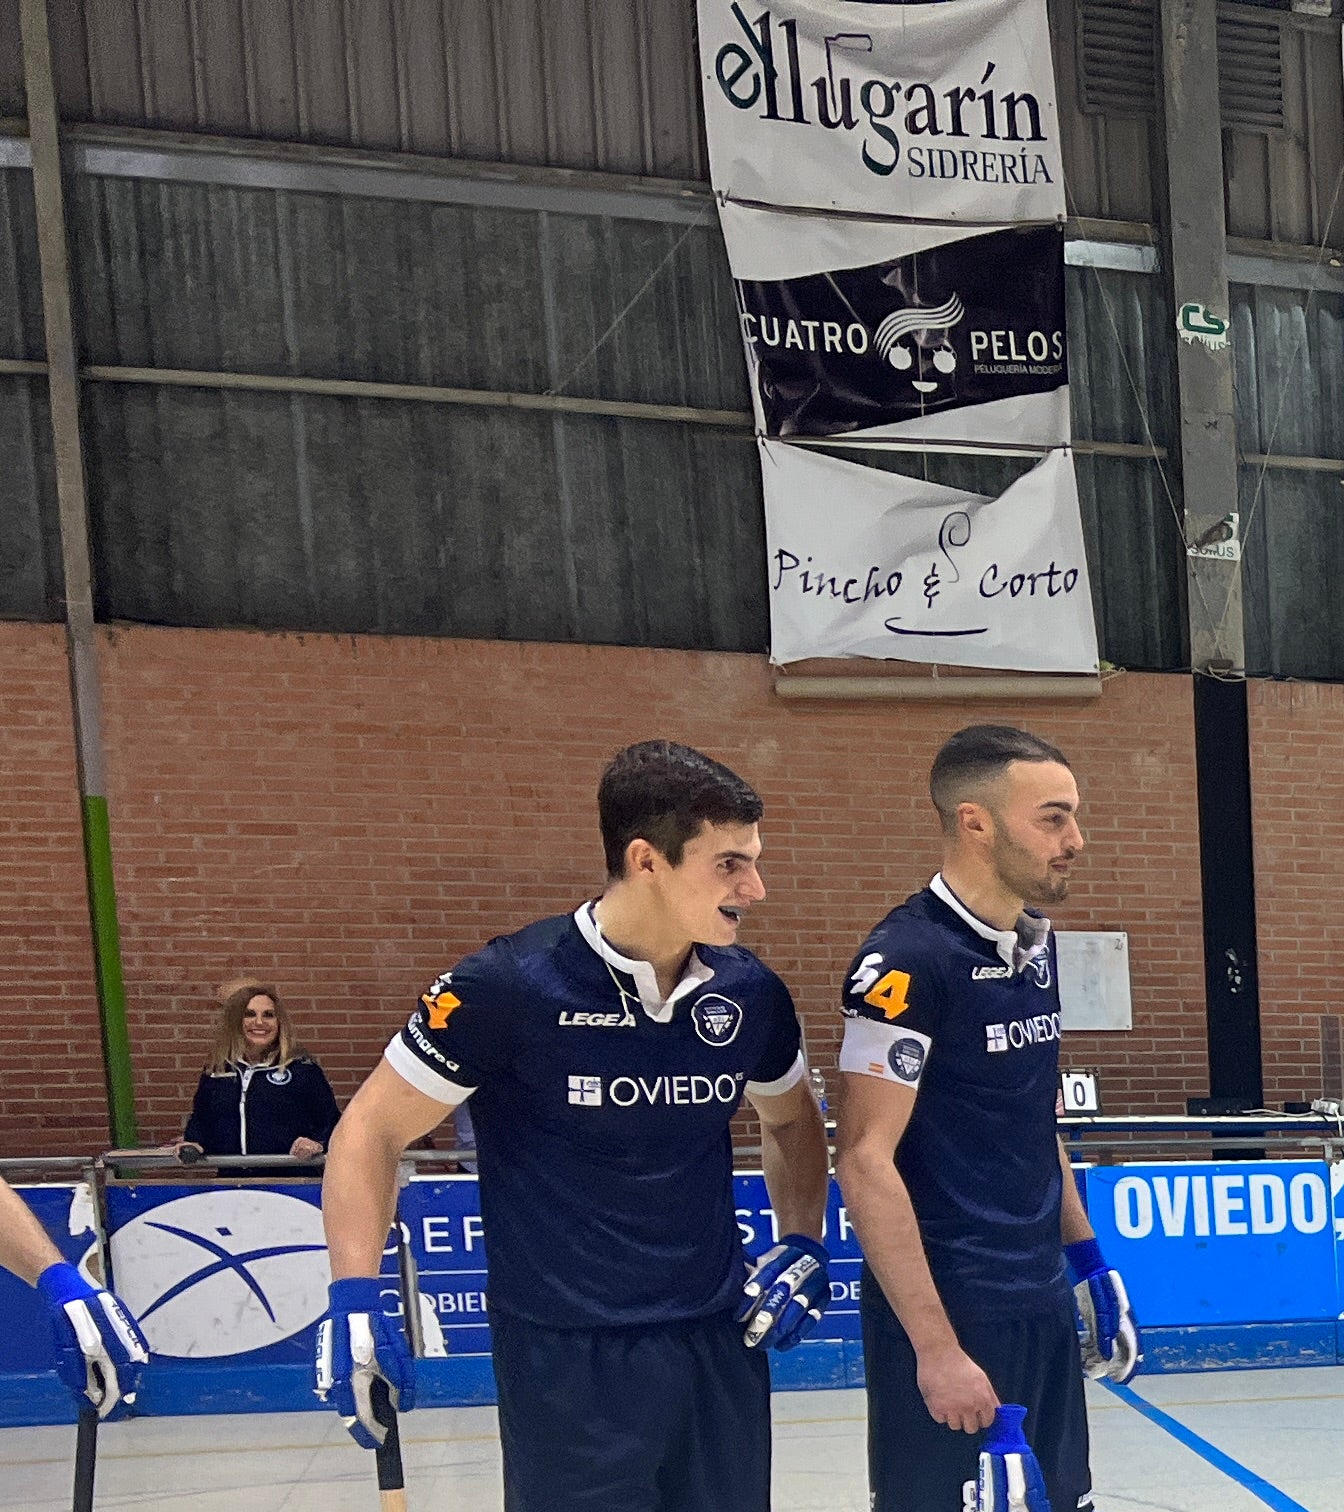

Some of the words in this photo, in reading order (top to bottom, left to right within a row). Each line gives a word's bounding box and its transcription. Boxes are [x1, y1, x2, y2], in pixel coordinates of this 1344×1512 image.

[908, 147, 1054, 184] SIDRERÍA
[741, 313, 868, 354] CUATRO
[970, 330, 1063, 361] PELOS
[774, 549, 902, 603] Pincho
[924, 563, 940, 608] &
[979, 562, 1079, 598] Corto
[972, 966, 1013, 980] LEGEA
[559, 1011, 636, 1027] LEGEA
[1008, 1012, 1061, 1048] OVIEDO
[609, 1074, 736, 1106] OVIEDO
[1073, 1081, 1086, 1107] 0
